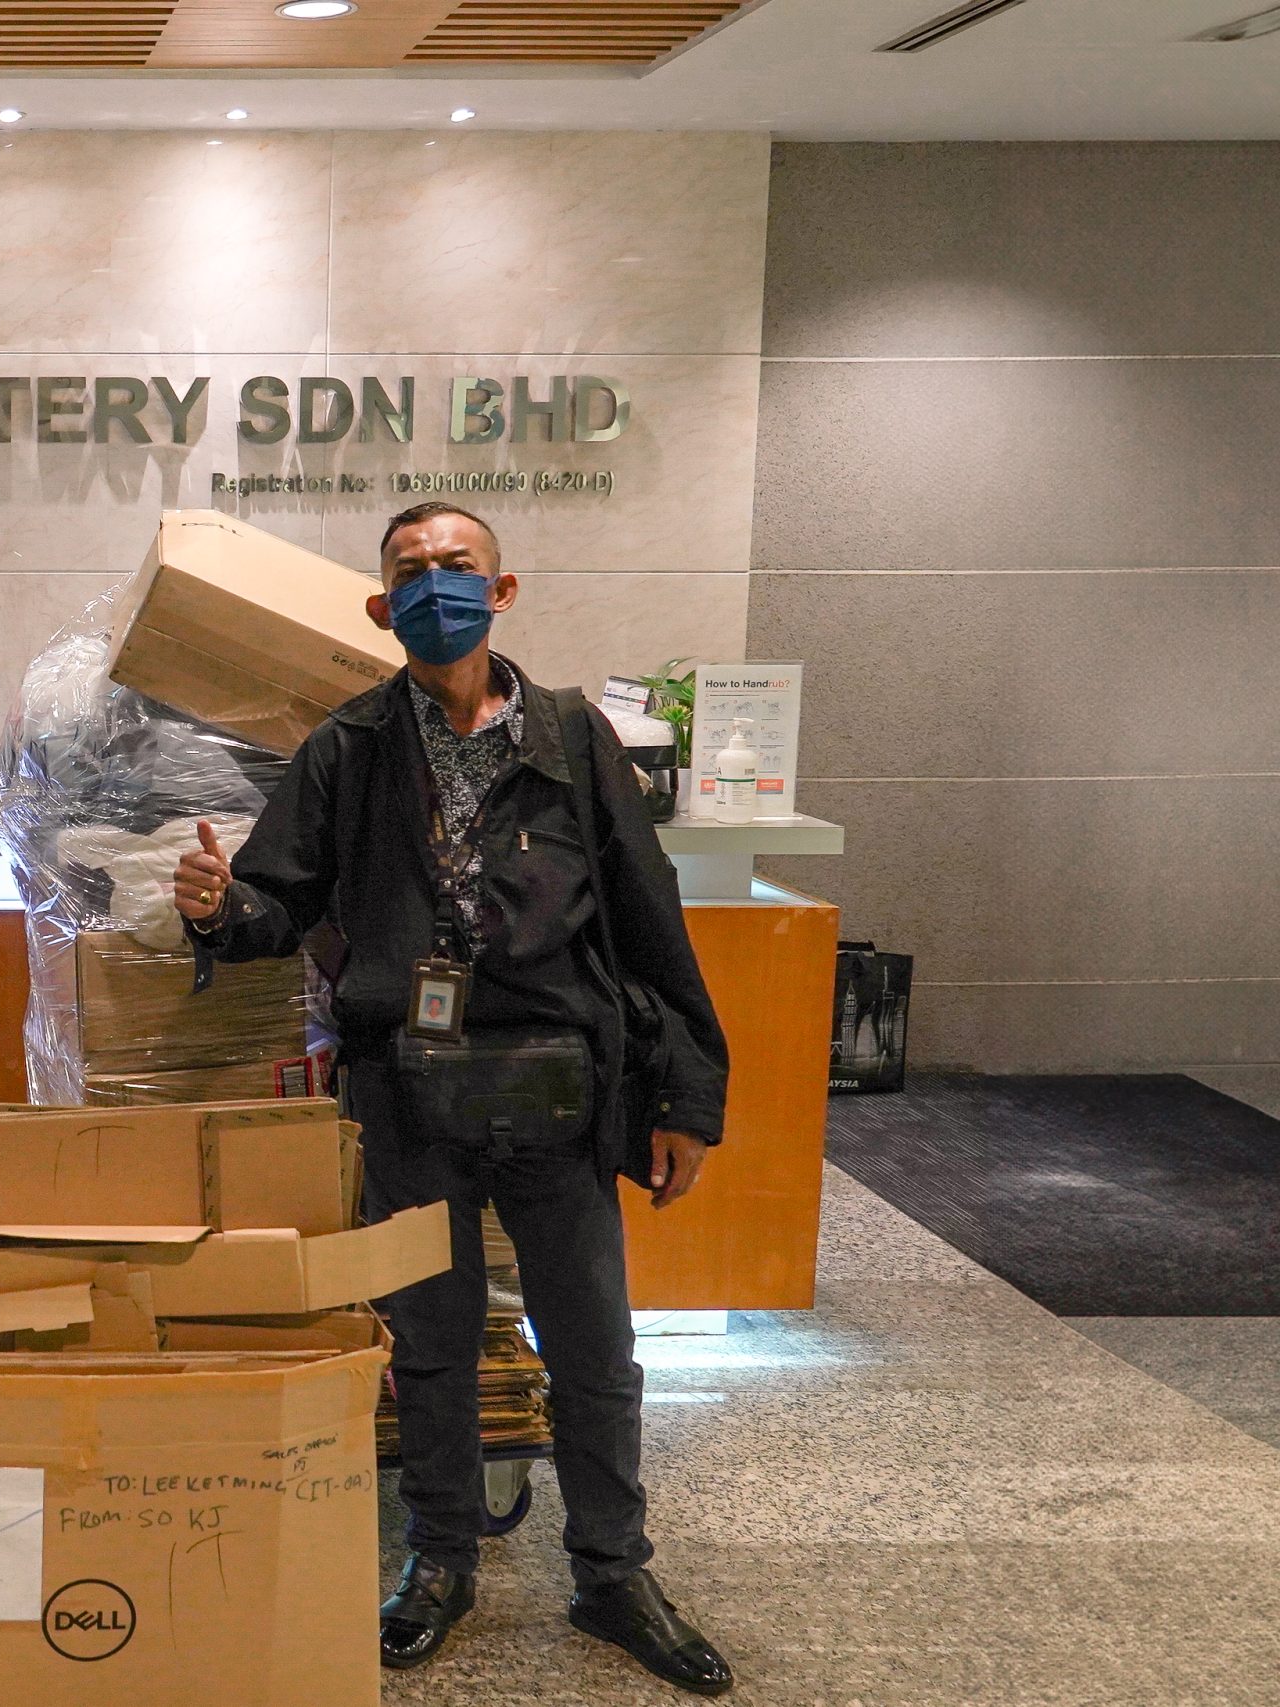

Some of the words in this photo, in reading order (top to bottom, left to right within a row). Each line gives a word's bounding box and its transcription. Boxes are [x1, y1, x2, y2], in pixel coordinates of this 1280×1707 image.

[236, 376, 415, 444] SDN
[450, 375, 630, 444] BHD
[212, 472, 333, 498] Registraton
[705, 679, 728, 688] How
[730, 680, 740, 688] to
[743, 679, 790, 688] Handrub?
[827, 1079, 860, 1088] AYSIA
[55, 1610, 126, 1632] DELL
